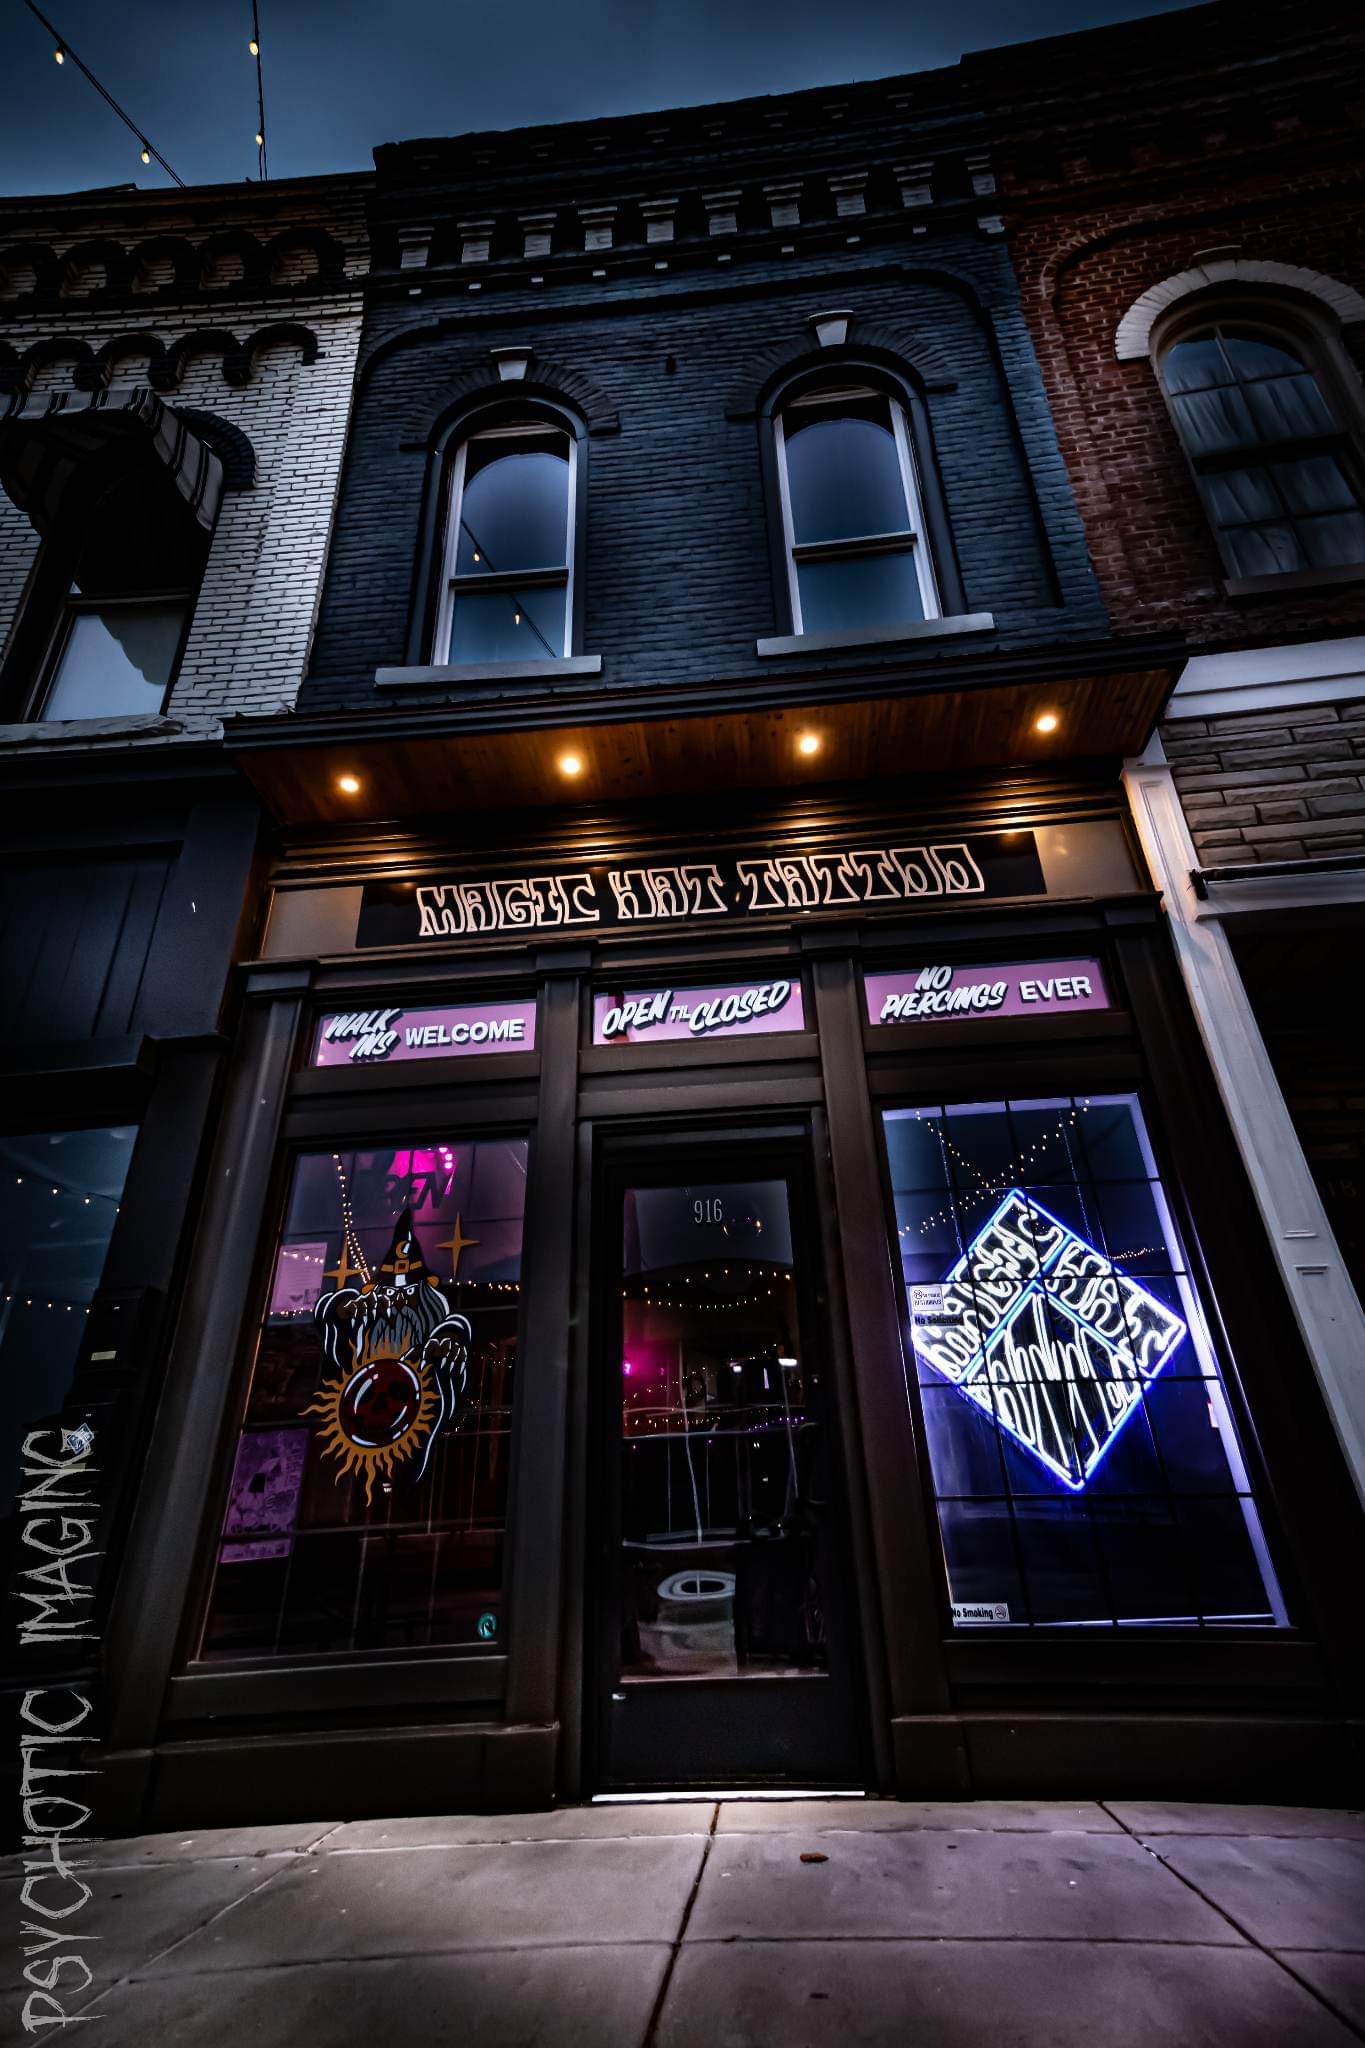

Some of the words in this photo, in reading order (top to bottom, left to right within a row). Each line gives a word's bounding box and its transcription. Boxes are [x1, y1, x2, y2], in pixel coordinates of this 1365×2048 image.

[416, 874, 600, 936] MAGIC
[608, 864, 728, 919] HAT
[737, 844, 984, 909] TATTOO
[914, 965, 951, 992] NO
[1019, 976, 1093, 1001] EVER
[601, 990, 672, 1036] OPEN
[670, 1004, 691, 1020] TIL
[689, 981, 790, 1032] CLOSED
[880, 981, 1008, 1020] PIERCINGS
[324, 1008, 400, 1039] WALK
[405, 1018, 525, 1047] WELCOME
[349, 1030, 397, 1059] INS
[694, 1198, 723, 1224] 916
[962, 1607, 994, 1620] Smoking
